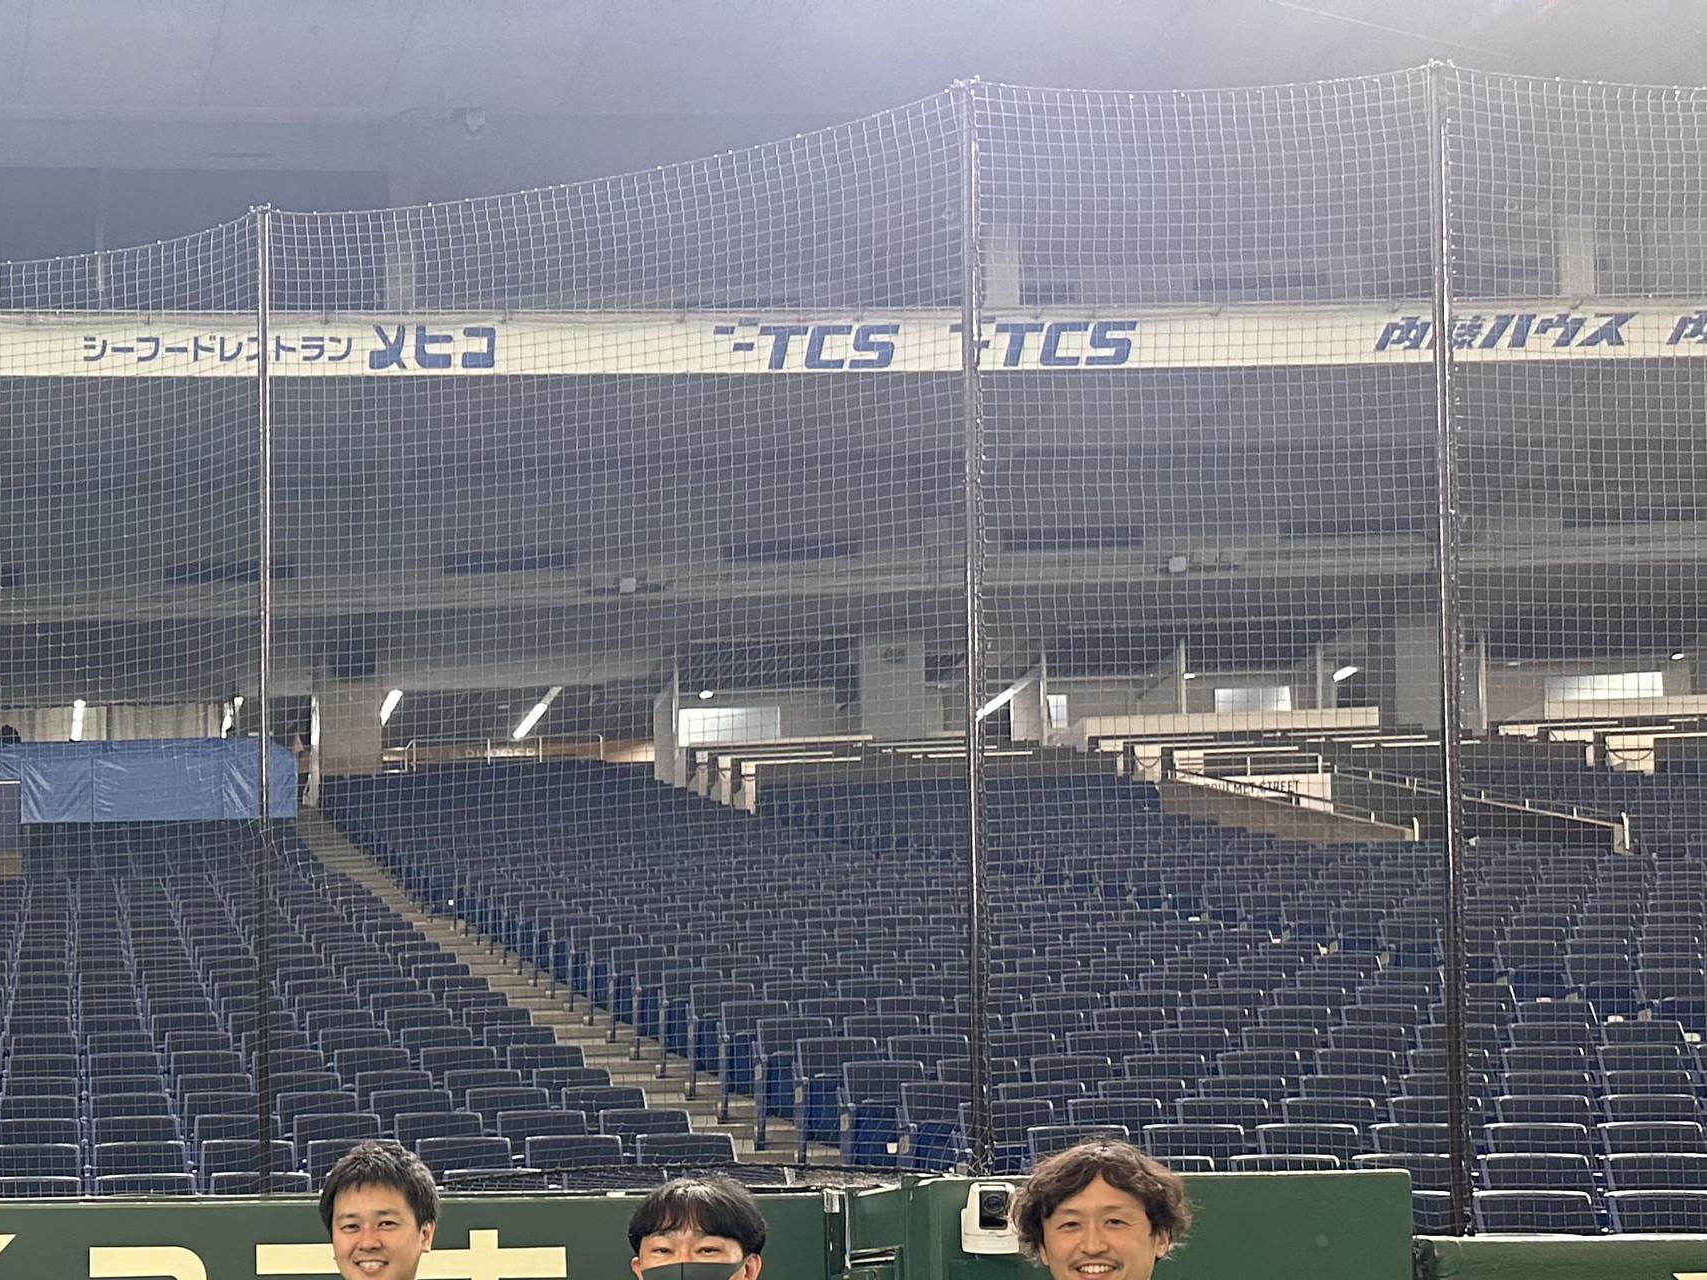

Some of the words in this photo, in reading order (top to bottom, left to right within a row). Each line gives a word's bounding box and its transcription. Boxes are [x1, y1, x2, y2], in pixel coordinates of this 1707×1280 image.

[369, 324, 496, 370] メヒコ
[759, 324, 900, 370] TCS
[995, 320, 1138, 367] TCS
